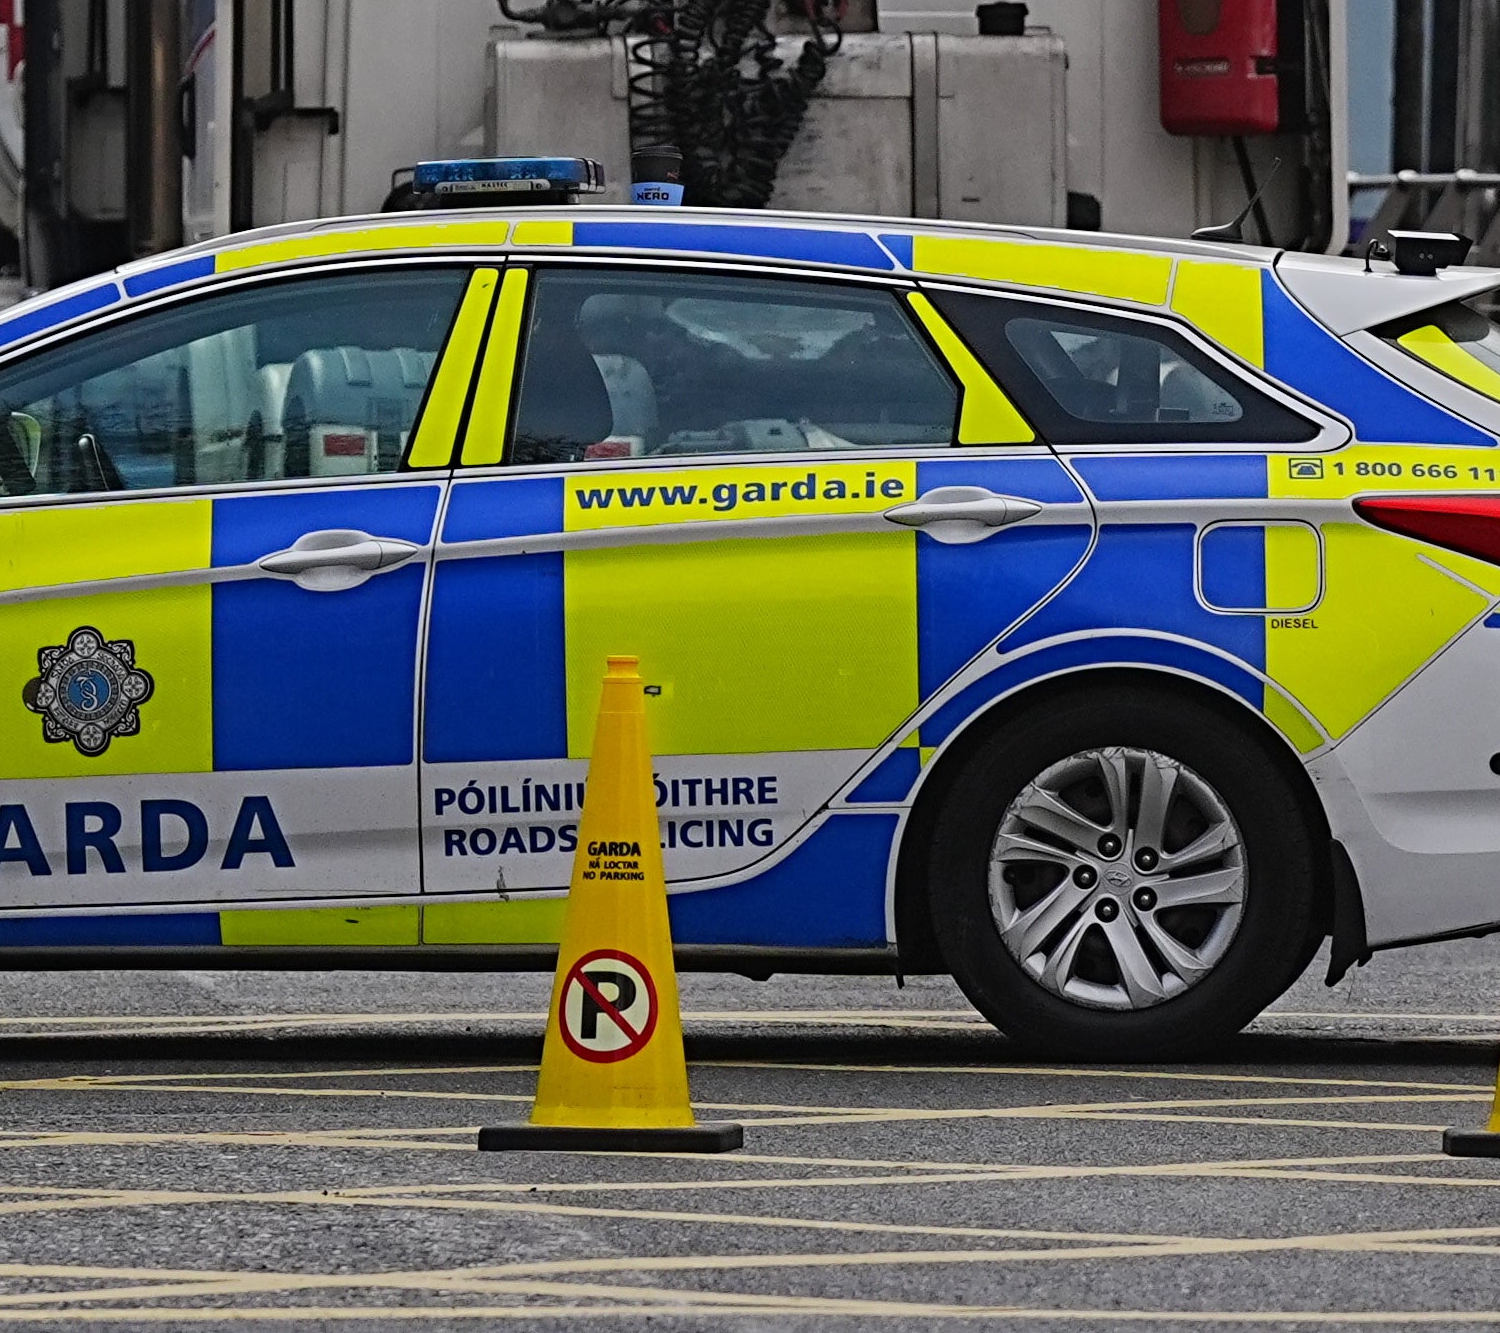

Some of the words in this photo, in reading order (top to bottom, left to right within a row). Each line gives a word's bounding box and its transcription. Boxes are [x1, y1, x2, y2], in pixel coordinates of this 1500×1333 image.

[1334, 462, 1343, 476] 1
[1355, 462, 1402, 477] 800
[1413, 464, 1457, 479] 666
[575, 472, 905, 512] www.garda.ie
[1271, 618, 1318, 629] DIESEL
[652, 772, 779, 807] ÓITHRE
[444, 824, 578, 856] ROADS
[587, 841, 641, 857] GARDA
[588, 857, 601, 869] NÁ
[604, 861, 639, 869] LOCTAR
[582, 871, 596, 880] NO
[599, 871, 645, 881] PARKING
